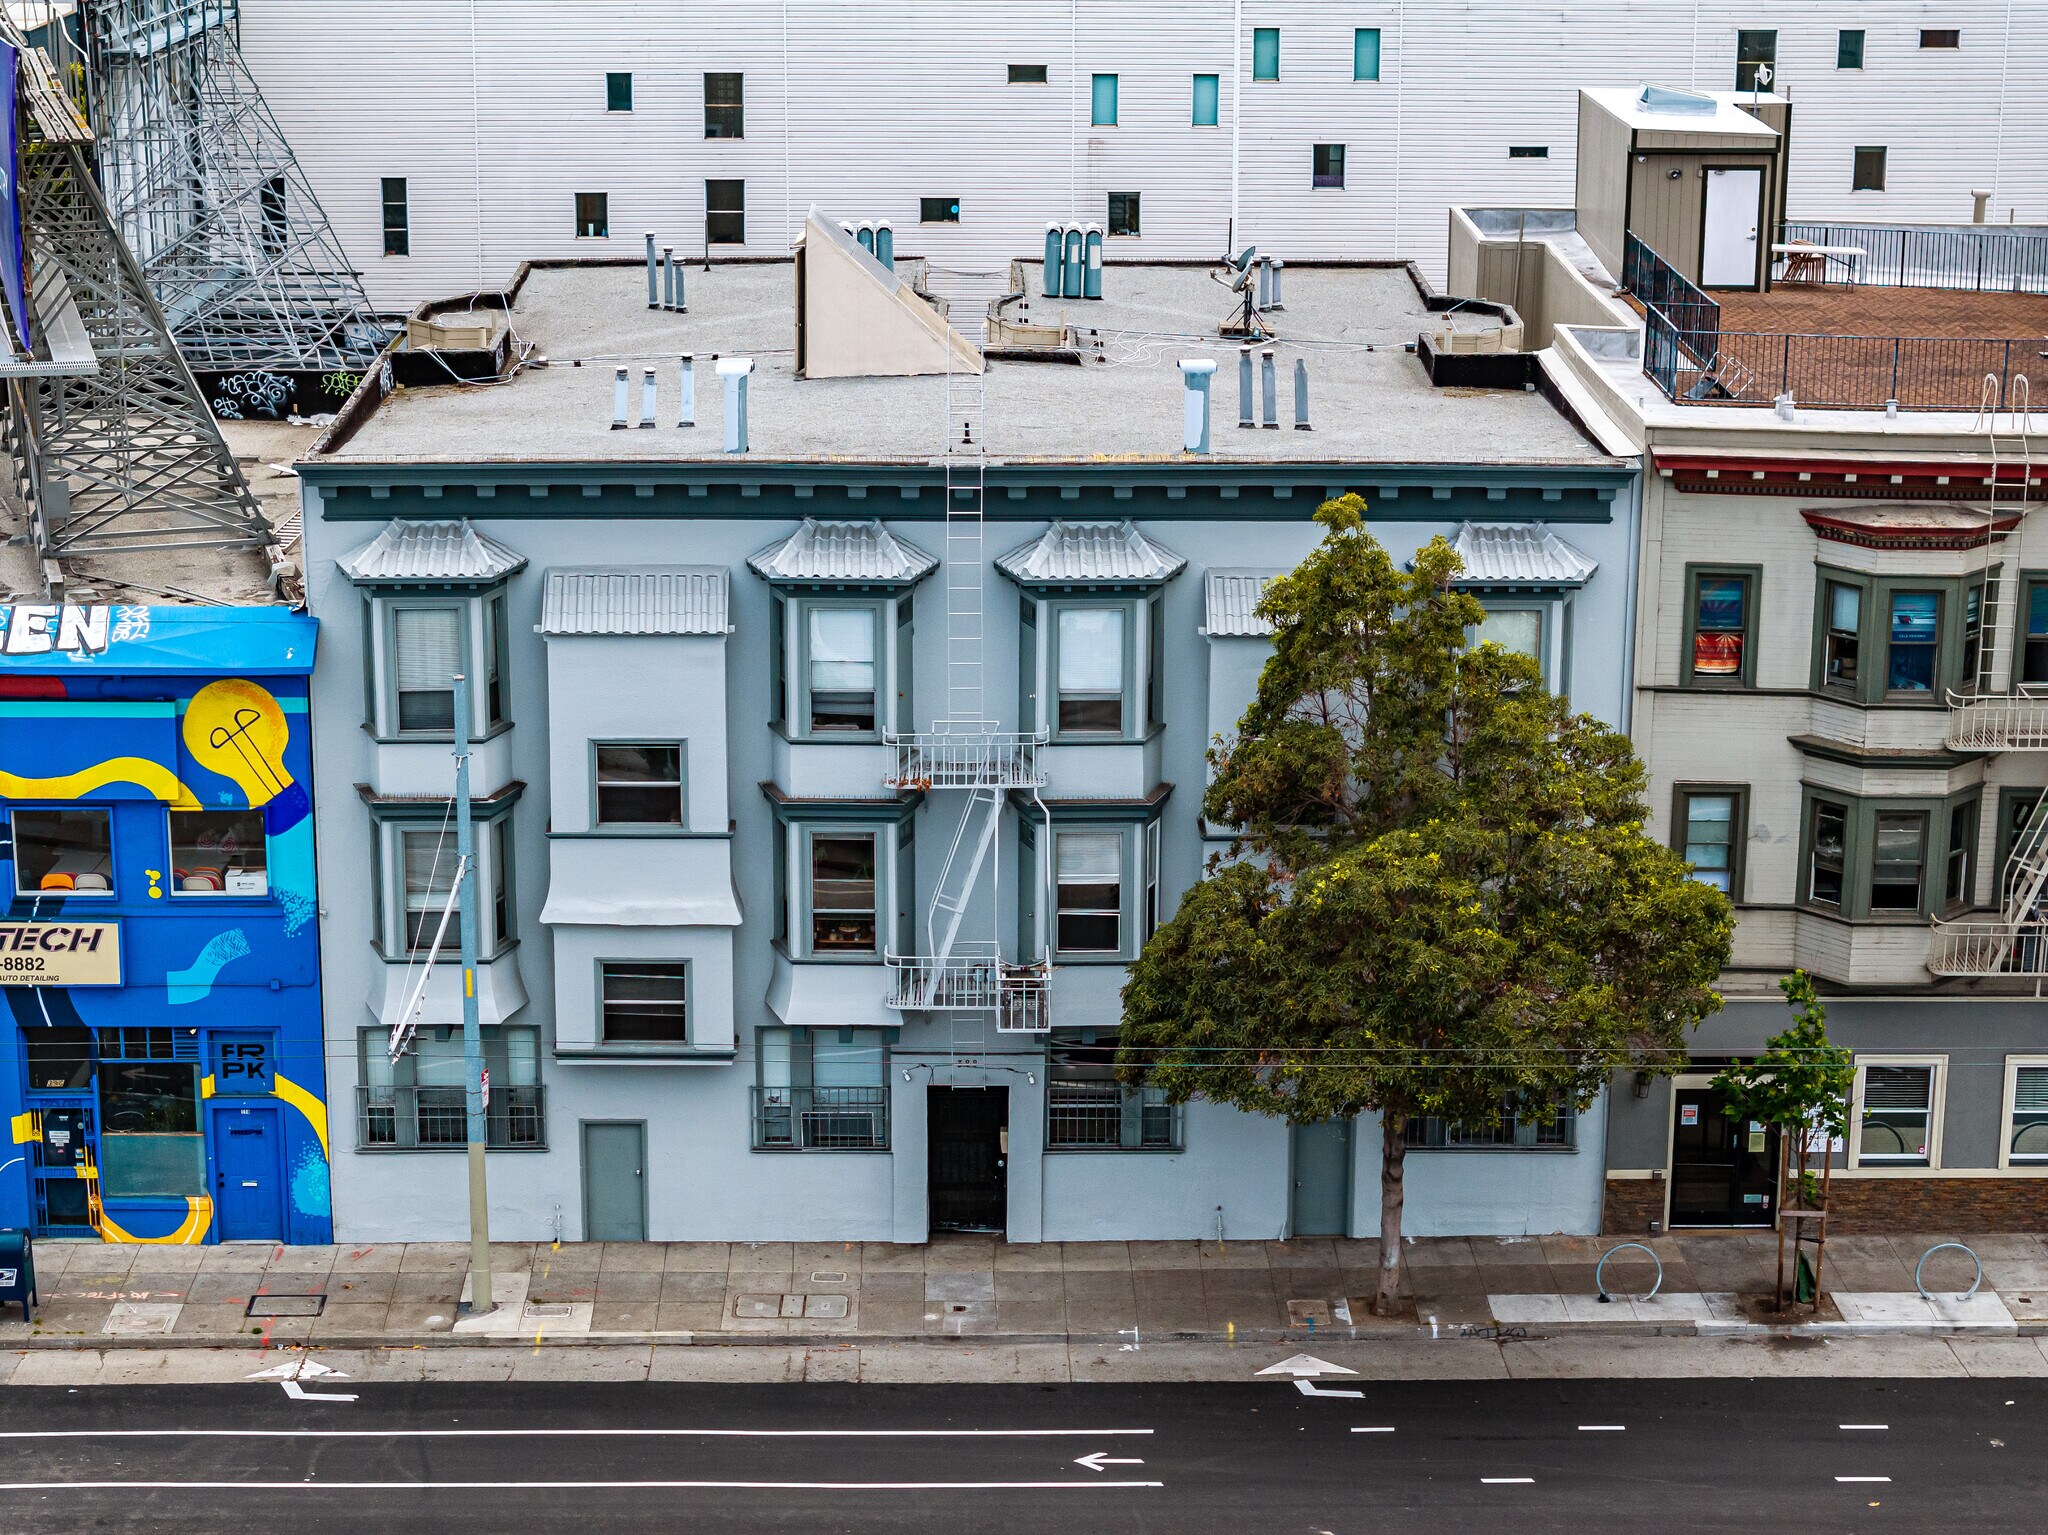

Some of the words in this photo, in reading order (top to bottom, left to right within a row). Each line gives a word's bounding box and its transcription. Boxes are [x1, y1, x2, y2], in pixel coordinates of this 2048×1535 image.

[20, 974, 60, 982] DETAILING
[221, 1043, 265, 1061] FR
[222, 1062, 266, 1079] PK
